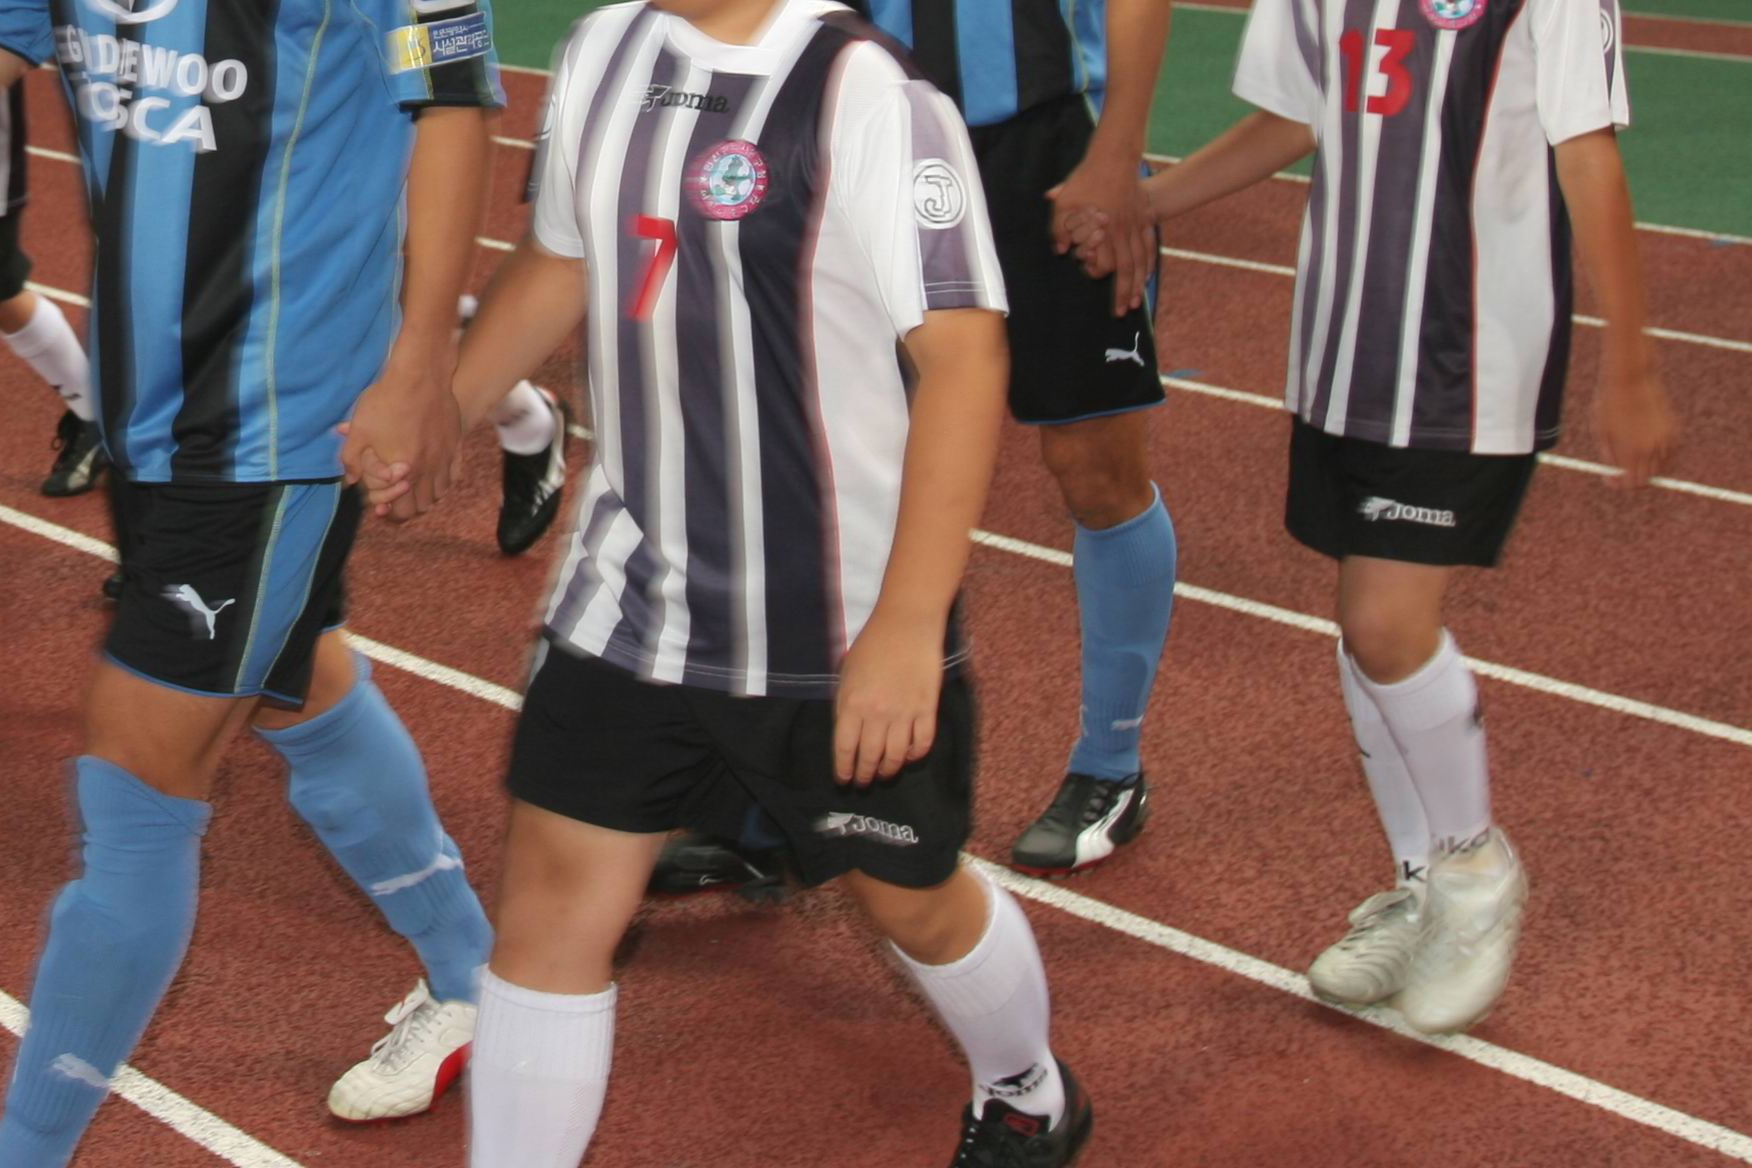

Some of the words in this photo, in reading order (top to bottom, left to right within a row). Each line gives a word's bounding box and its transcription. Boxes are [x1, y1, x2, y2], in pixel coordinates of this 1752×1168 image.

[1339, 26, 1416, 118] 13
[629, 213, 679, 322] 7
[1386, 501, 1456, 527] Joma
[851, 814, 920, 844] Joma
